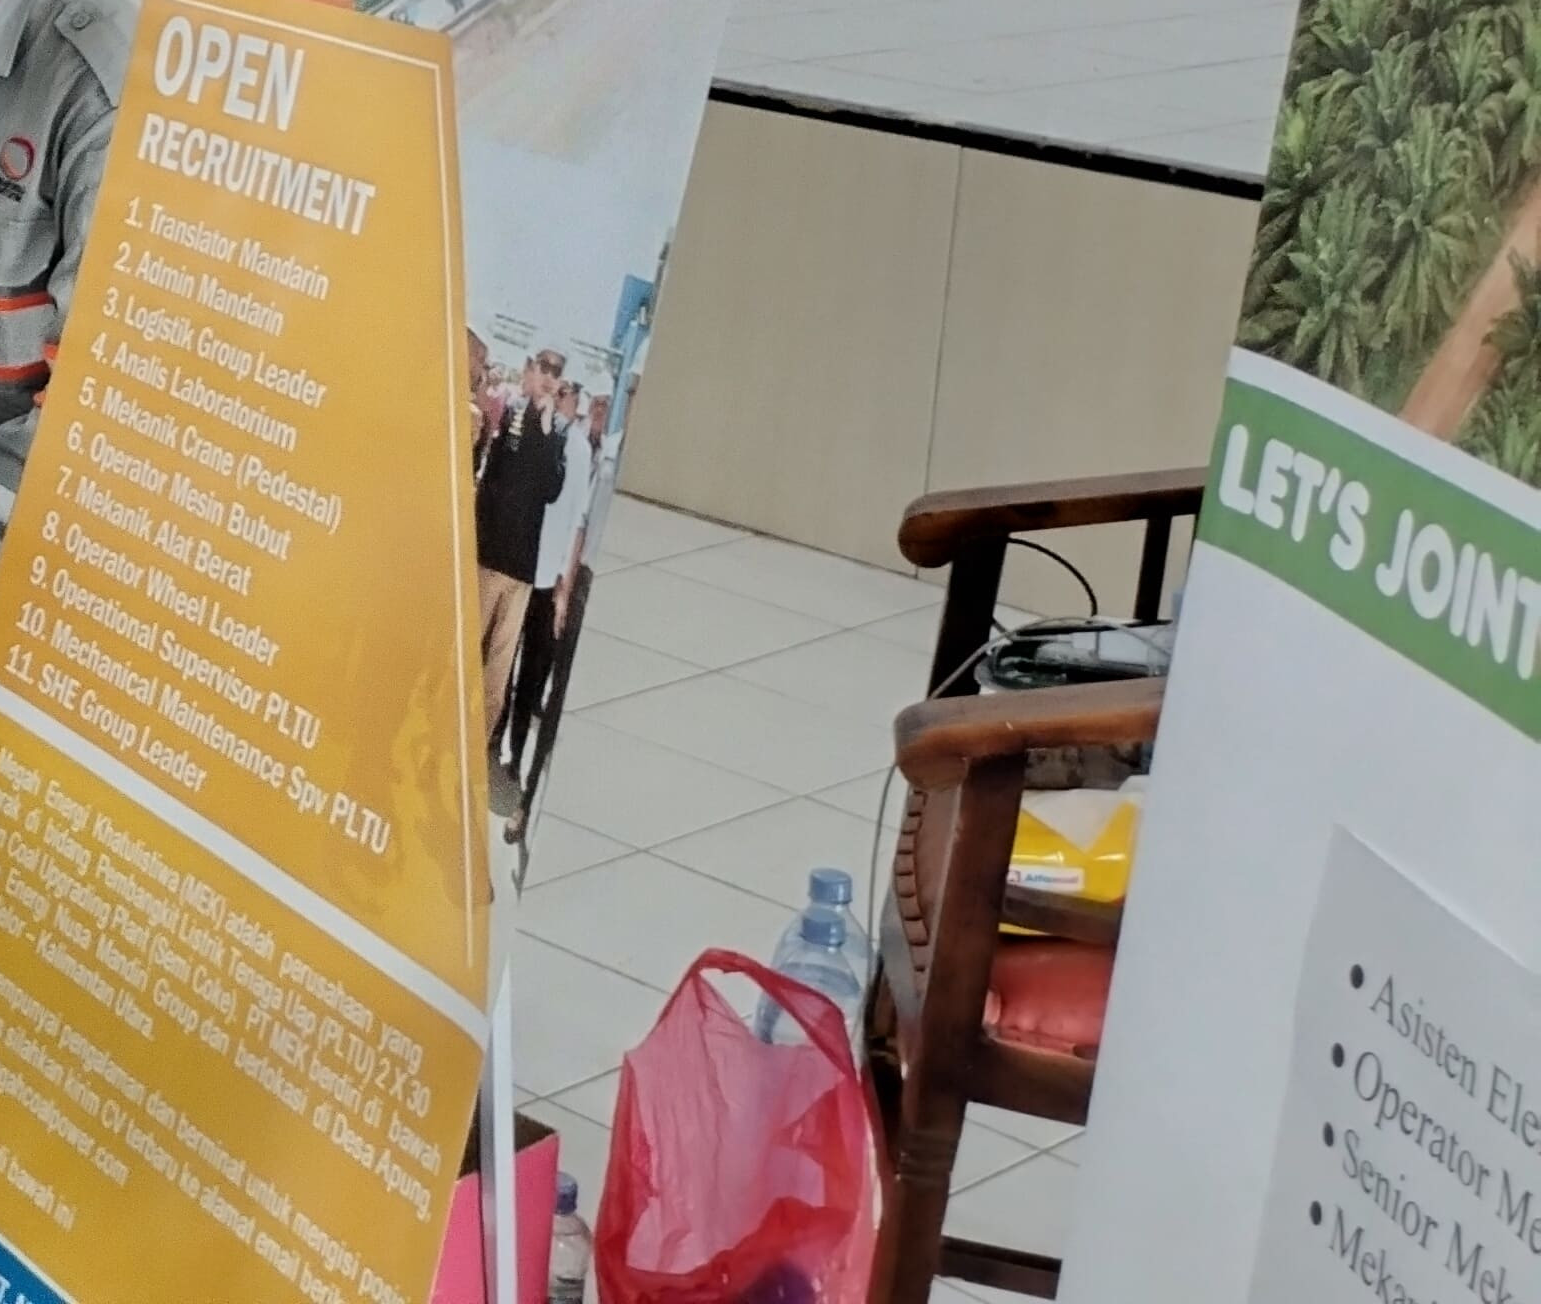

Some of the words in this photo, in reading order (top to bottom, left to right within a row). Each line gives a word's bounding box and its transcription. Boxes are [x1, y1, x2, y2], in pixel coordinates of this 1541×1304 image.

[154, 15, 304, 131] OPEN
[137, 113, 376, 235] RECRUITMENT
[113, 242, 132, 274] 2.
[135, 250, 196, 299] Admin
[197, 274, 285, 337] Mandarin
[124, 196, 143, 229] 1.
[150, 204, 237, 263] Translator
[237, 239, 329, 300] Mandarin
[90, 331, 108, 364] 4.
[111, 341, 168, 390] Analis
[170, 367, 298, 453] Laboratorium
[102, 286, 120, 319] 3.
[125, 295, 193, 351] Logistik
[196, 325, 253, 382] Group
[254, 351, 328, 409] Leader
[66, 421, 85, 456] 6.
[89, 432, 169, 499] Operator
[169, 472, 226, 527] Mesin
[228, 502, 292, 561] Bubut
[78, 376, 97, 411] 5.
[100, 386, 179, 449] Mekanik
[181, 425, 235, 476] Crane
[237, 453, 343, 535] (Pedestal)
[1219, 423, 1371, 571] LET'S
[41, 510, 61, 545] 8.
[65, 523, 145, 589] Operator
[145, 566, 208, 628] Wheel
[209, 601, 280, 667] Loader
[55, 464, 73, 500] 7.
[74, 476, 153, 540] Mekanik
[152, 521, 194, 565] Alat
[194, 545, 254, 597] Berat
[4, 643, 35, 686] 11.
[38, 663, 80, 711] SHE
[80, 691, 138, 750] Group
[138, 725, 208, 792] Leader
[29, 555, 47, 590] 9.
[52, 568, 158, 653] Operational
[158, 629, 263, 716] Supervisor
[263, 689, 322, 750] PLTU
[16, 600, 46, 643] 10.
[51, 618, 157, 707] Mechanical
[158, 682, 286, 789] Maintenance
[287, 764, 327, 816] Spv
[328, 791, 391, 856] PLTU
[228, 946, 285, 1011] Tenaga
[285, 989, 317, 1037] Uap
[318, 1015, 376, 1084] (PLTU)
[374, 1057, 391, 1088] 2
[406, 1084, 432, 1119] 30
[278, 951, 374, 1032] perusahaan
[377, 1022, 424, 1076] yang
[1369, 974, 1477, 1098] Asisten
[152, 977, 199, 1035] Group
[199, 1017, 230, 1056] dan
[312, 1102, 331, 1134] di
[330, 1112, 376, 1171] Desa
[374, 1149, 432, 1223] Apung,
[245, 1002, 272, 1041] PT
[268, 1021, 310, 1074] MEK
[363, 1095, 383, 1129] di
[387, 1111, 442, 1177] bawah
[1353, 1050, 1493, 1200] Operator
[245, 1169, 293, 1227] untuk
[291, 1210, 360, 1281] mengisi
[1342, 1127, 1439, 1249] Senior
